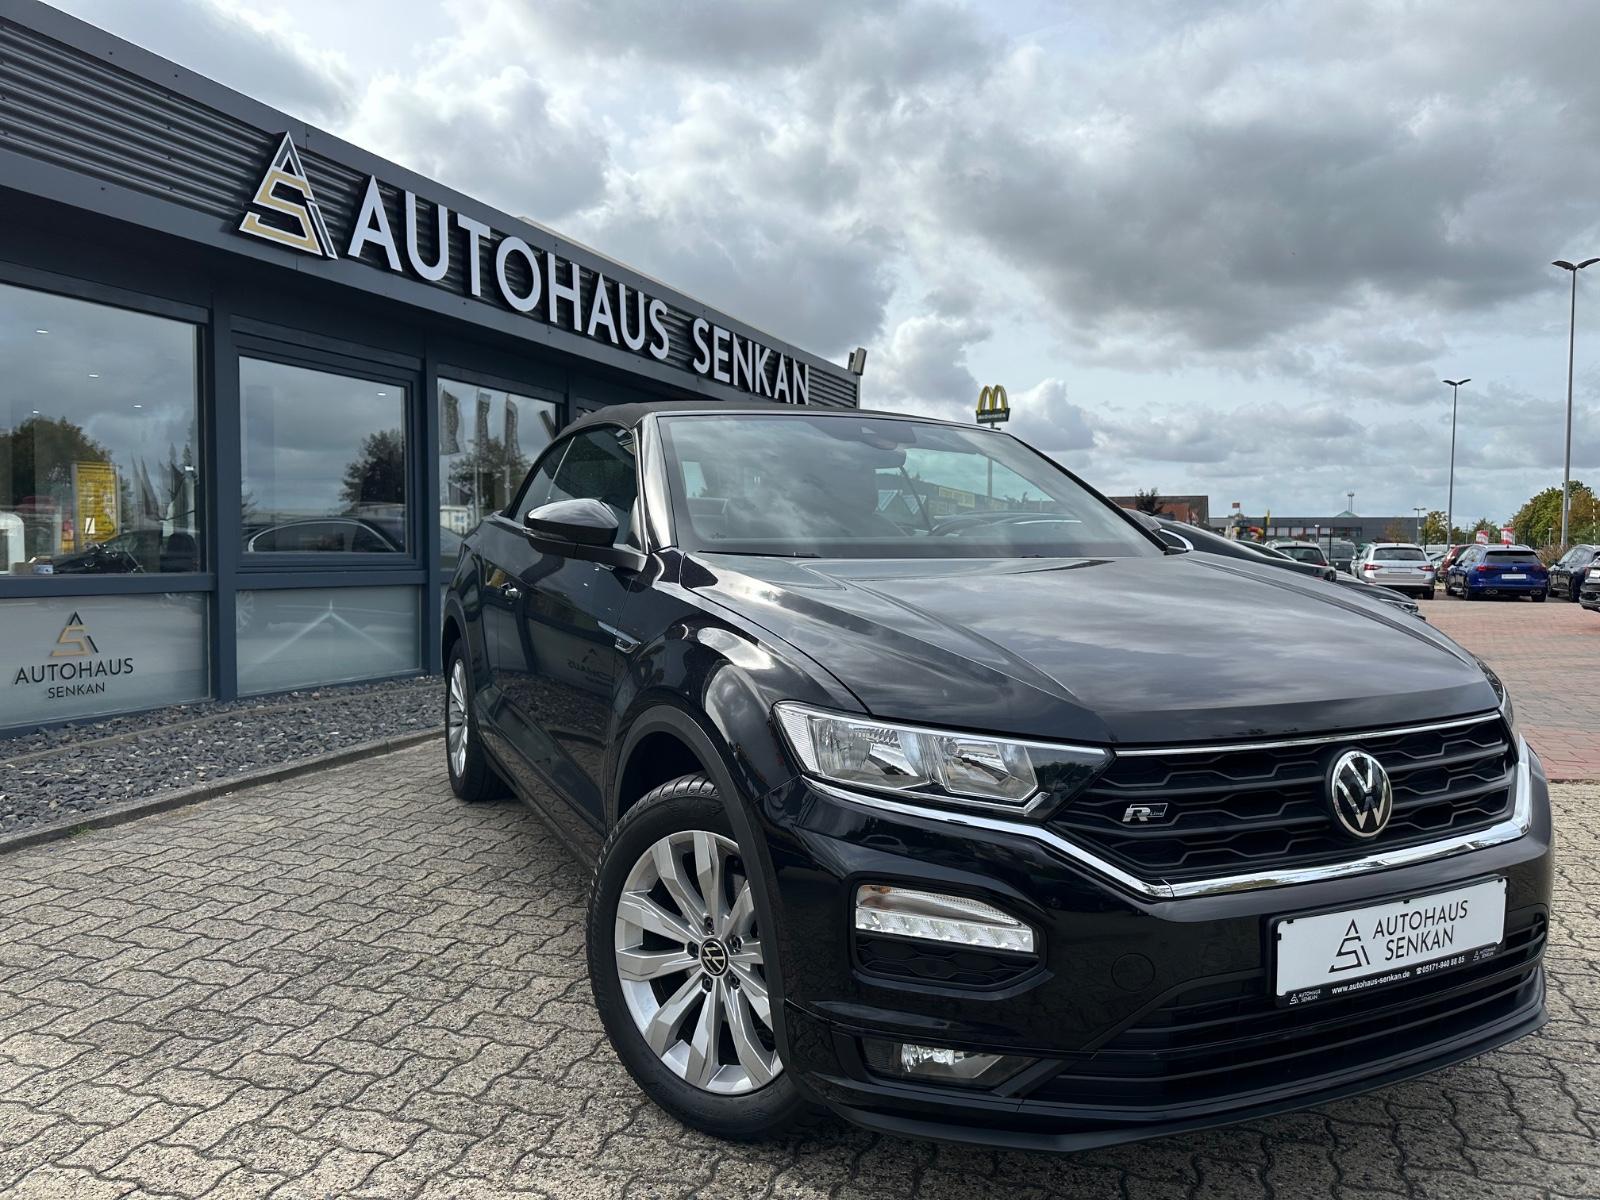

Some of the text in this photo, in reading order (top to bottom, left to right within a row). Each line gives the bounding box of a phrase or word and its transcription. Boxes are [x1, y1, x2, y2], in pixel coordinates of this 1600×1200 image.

[348, 175, 809, 405] AUTOHAUS SENKAN
[15, 657, 134, 686] AUTOHAUS
[47, 681, 105, 699] SENKAN
[1373, 900, 1468, 939] AUTOHAUS
[1385, 926, 1454, 960] SENKAN
[1331, 970, 1411, 995] www.autohaus-senkan.de
